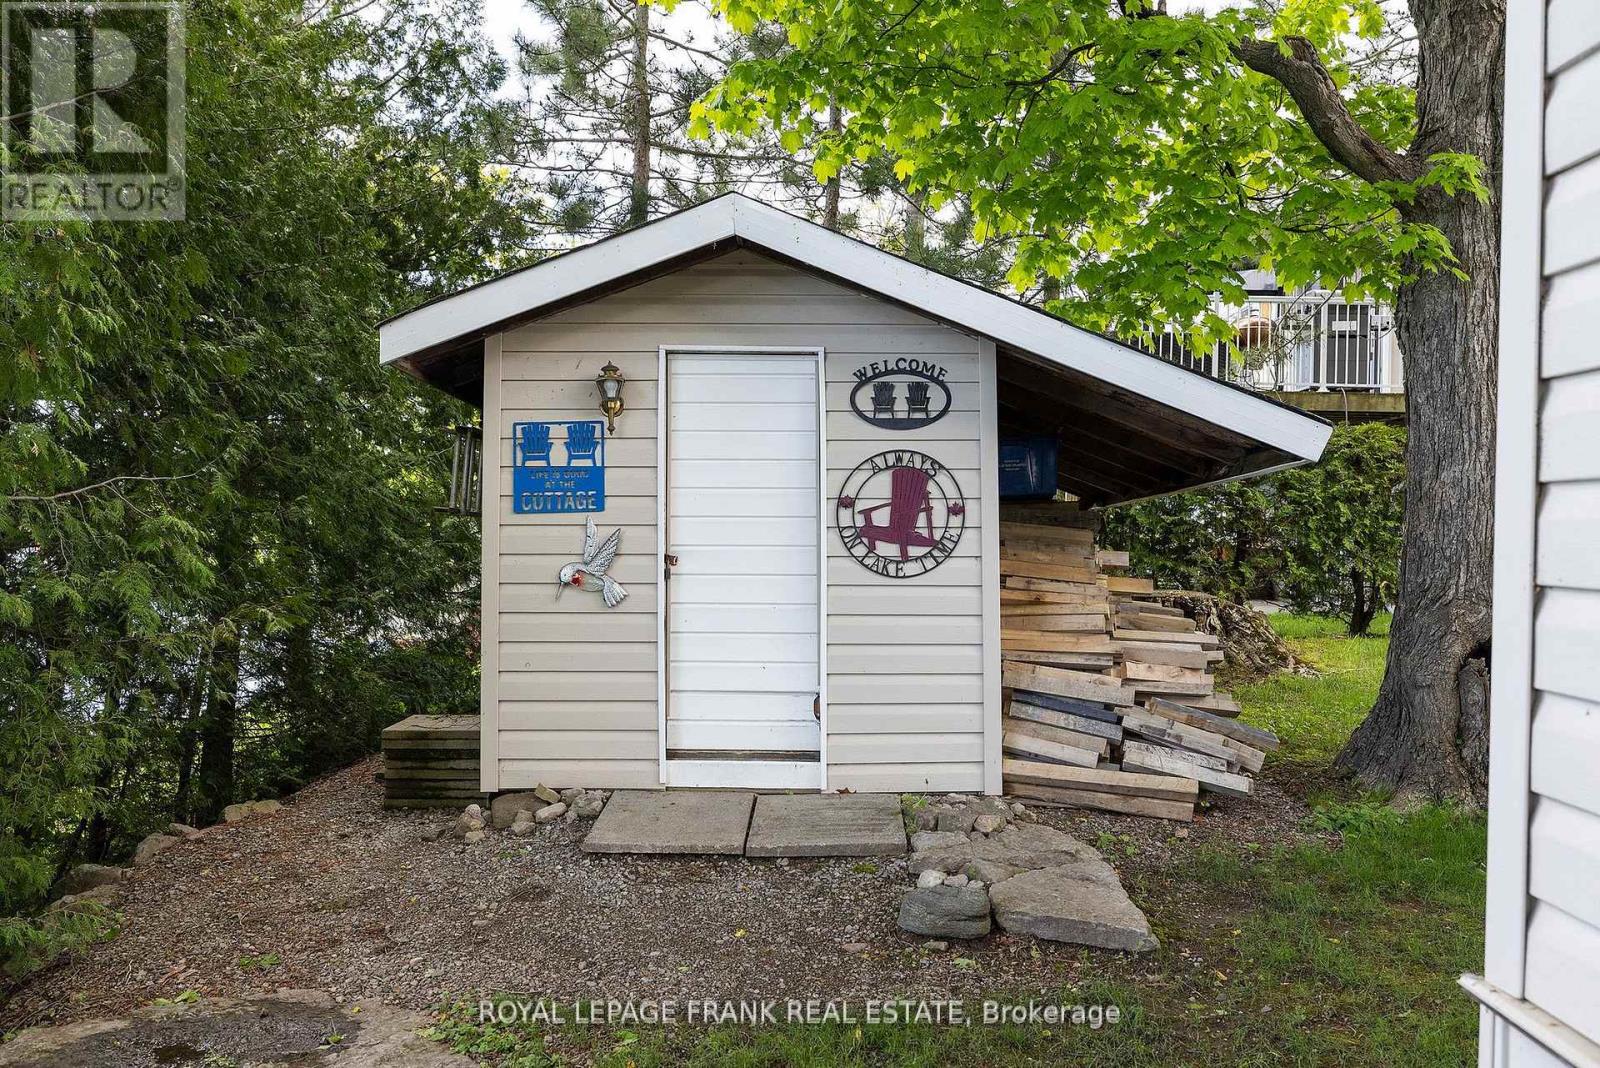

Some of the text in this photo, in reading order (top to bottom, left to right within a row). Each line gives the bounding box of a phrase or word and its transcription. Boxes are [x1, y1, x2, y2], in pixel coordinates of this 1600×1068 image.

[852, 357, 948, 381] WELCOME
[868, 450, 942, 478] ALWAYS
[544, 480, 576, 489] AT THE
[521, 491, 597, 511] COTTAGE
[840, 525, 960, 577] ON LAKE TIME
